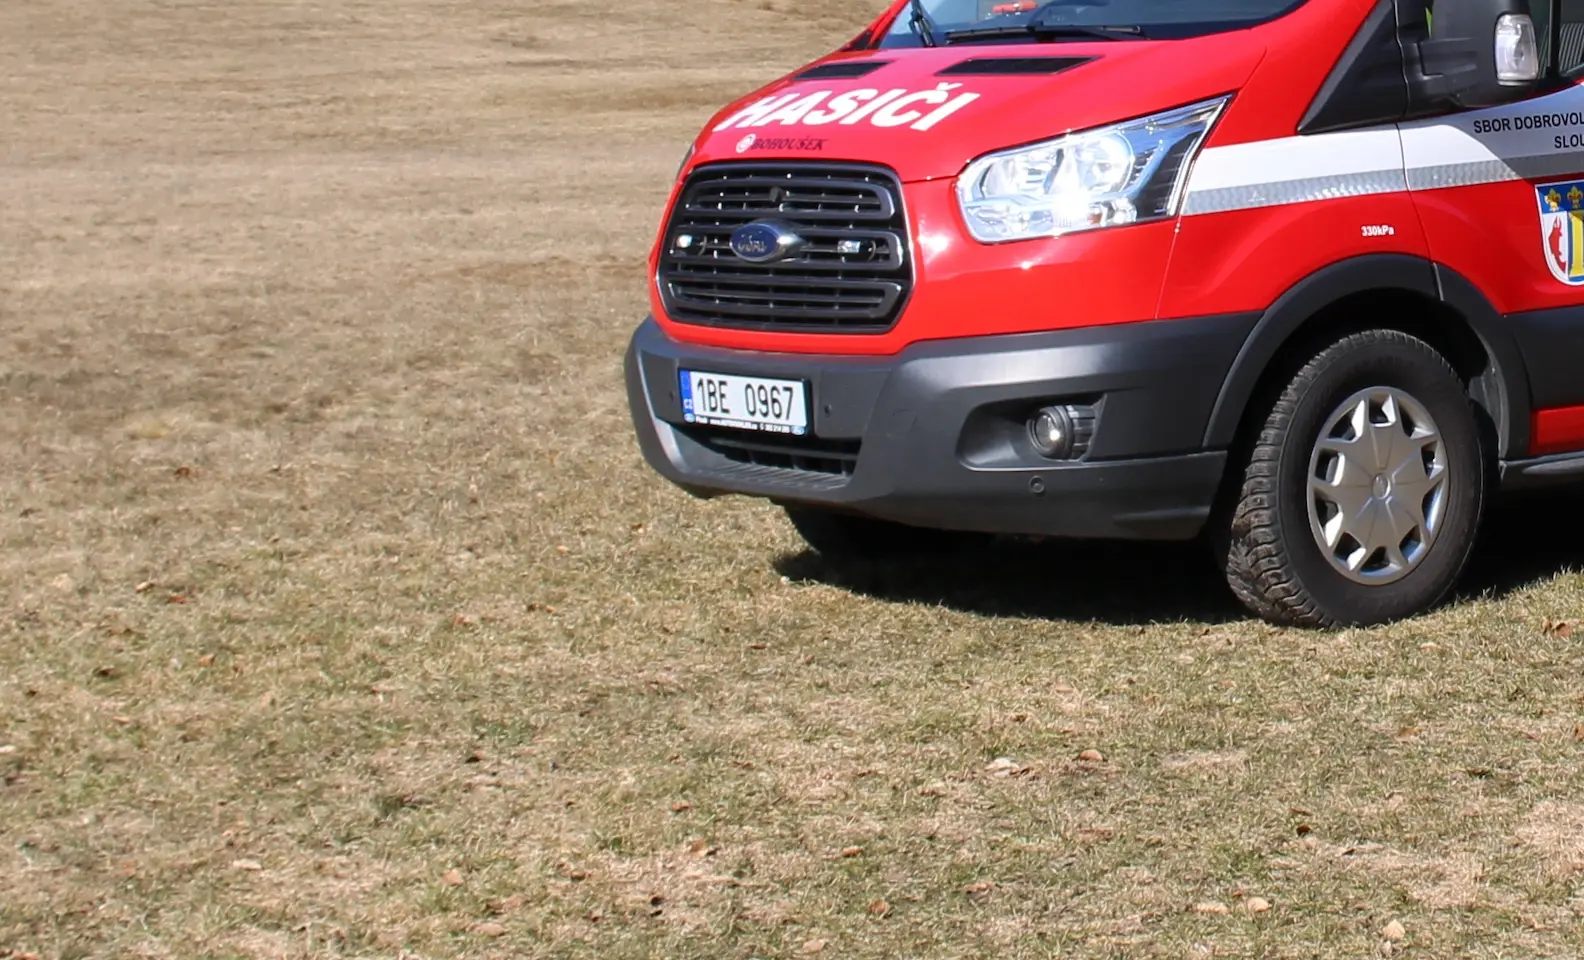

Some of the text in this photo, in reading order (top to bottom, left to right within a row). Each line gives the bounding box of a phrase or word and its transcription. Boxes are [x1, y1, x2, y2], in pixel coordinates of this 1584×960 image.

[712, 82, 981, 131] HASIČI
[1473, 117, 1512, 134] SBOR
[1360, 224, 1395, 237] 330kPa
[697, 378, 794, 421] 1BE 0967
